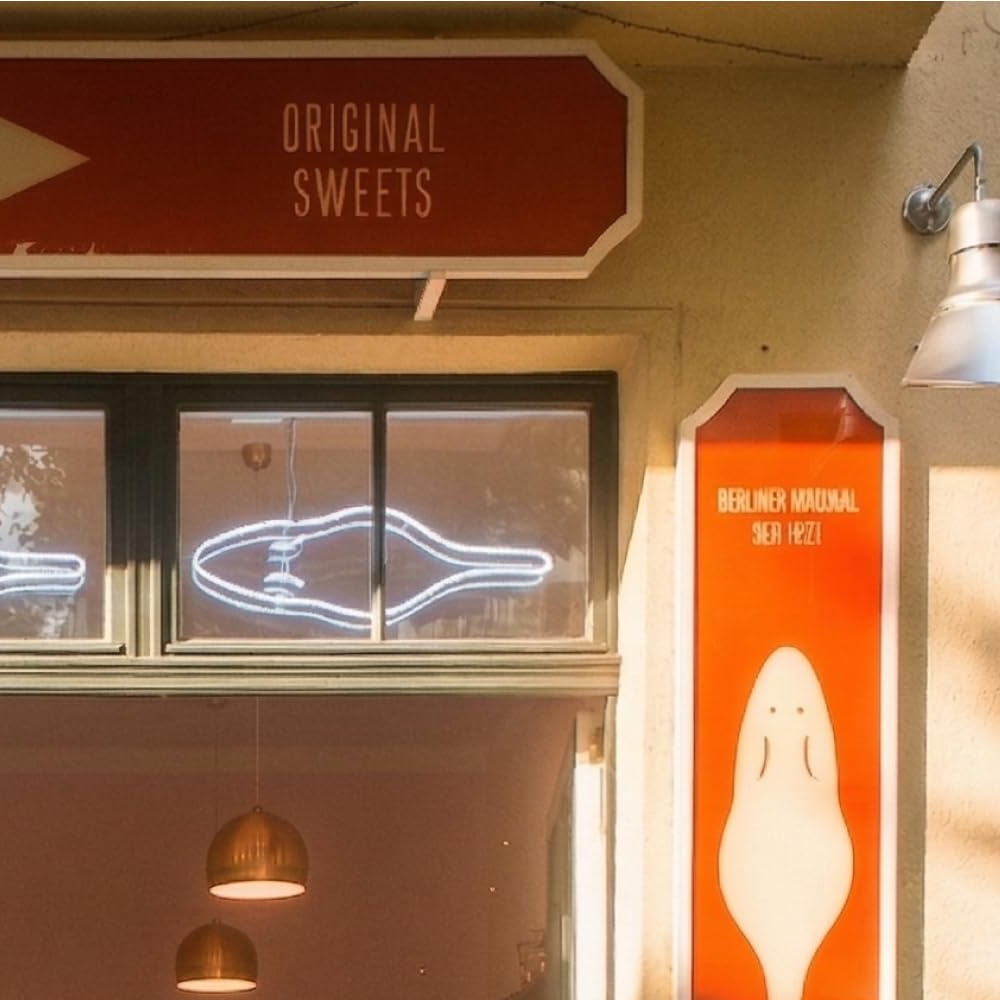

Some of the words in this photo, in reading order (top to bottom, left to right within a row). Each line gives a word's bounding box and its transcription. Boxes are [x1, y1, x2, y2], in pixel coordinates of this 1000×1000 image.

[283, 102, 446, 153] ORIGINAL
[293, 167, 432, 218] SWEETS
[717, 487, 787, 514] BERLINER
